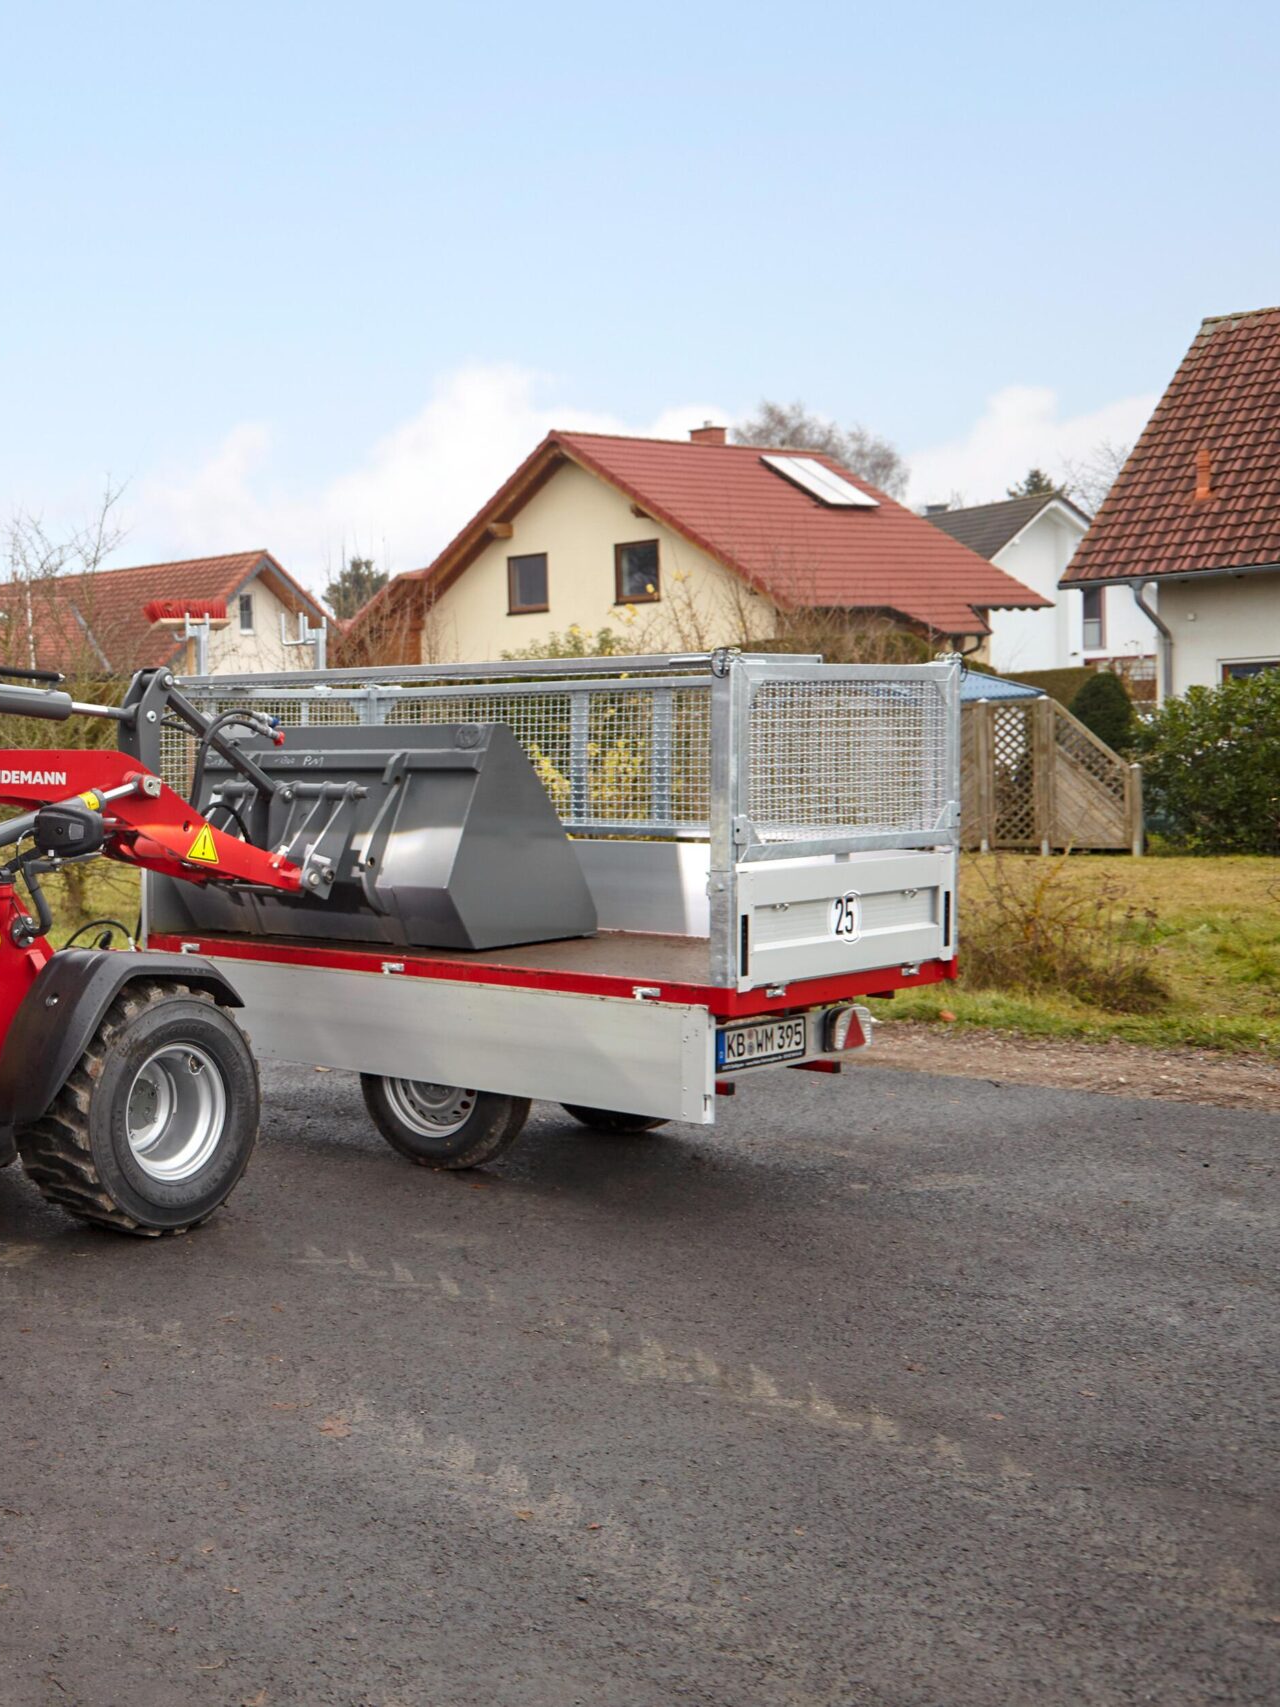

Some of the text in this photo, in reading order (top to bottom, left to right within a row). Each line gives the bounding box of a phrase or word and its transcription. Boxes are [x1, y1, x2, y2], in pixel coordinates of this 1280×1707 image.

[835, 897, 854, 935] 25
[727, 1022, 802, 1058] KB WM 395
